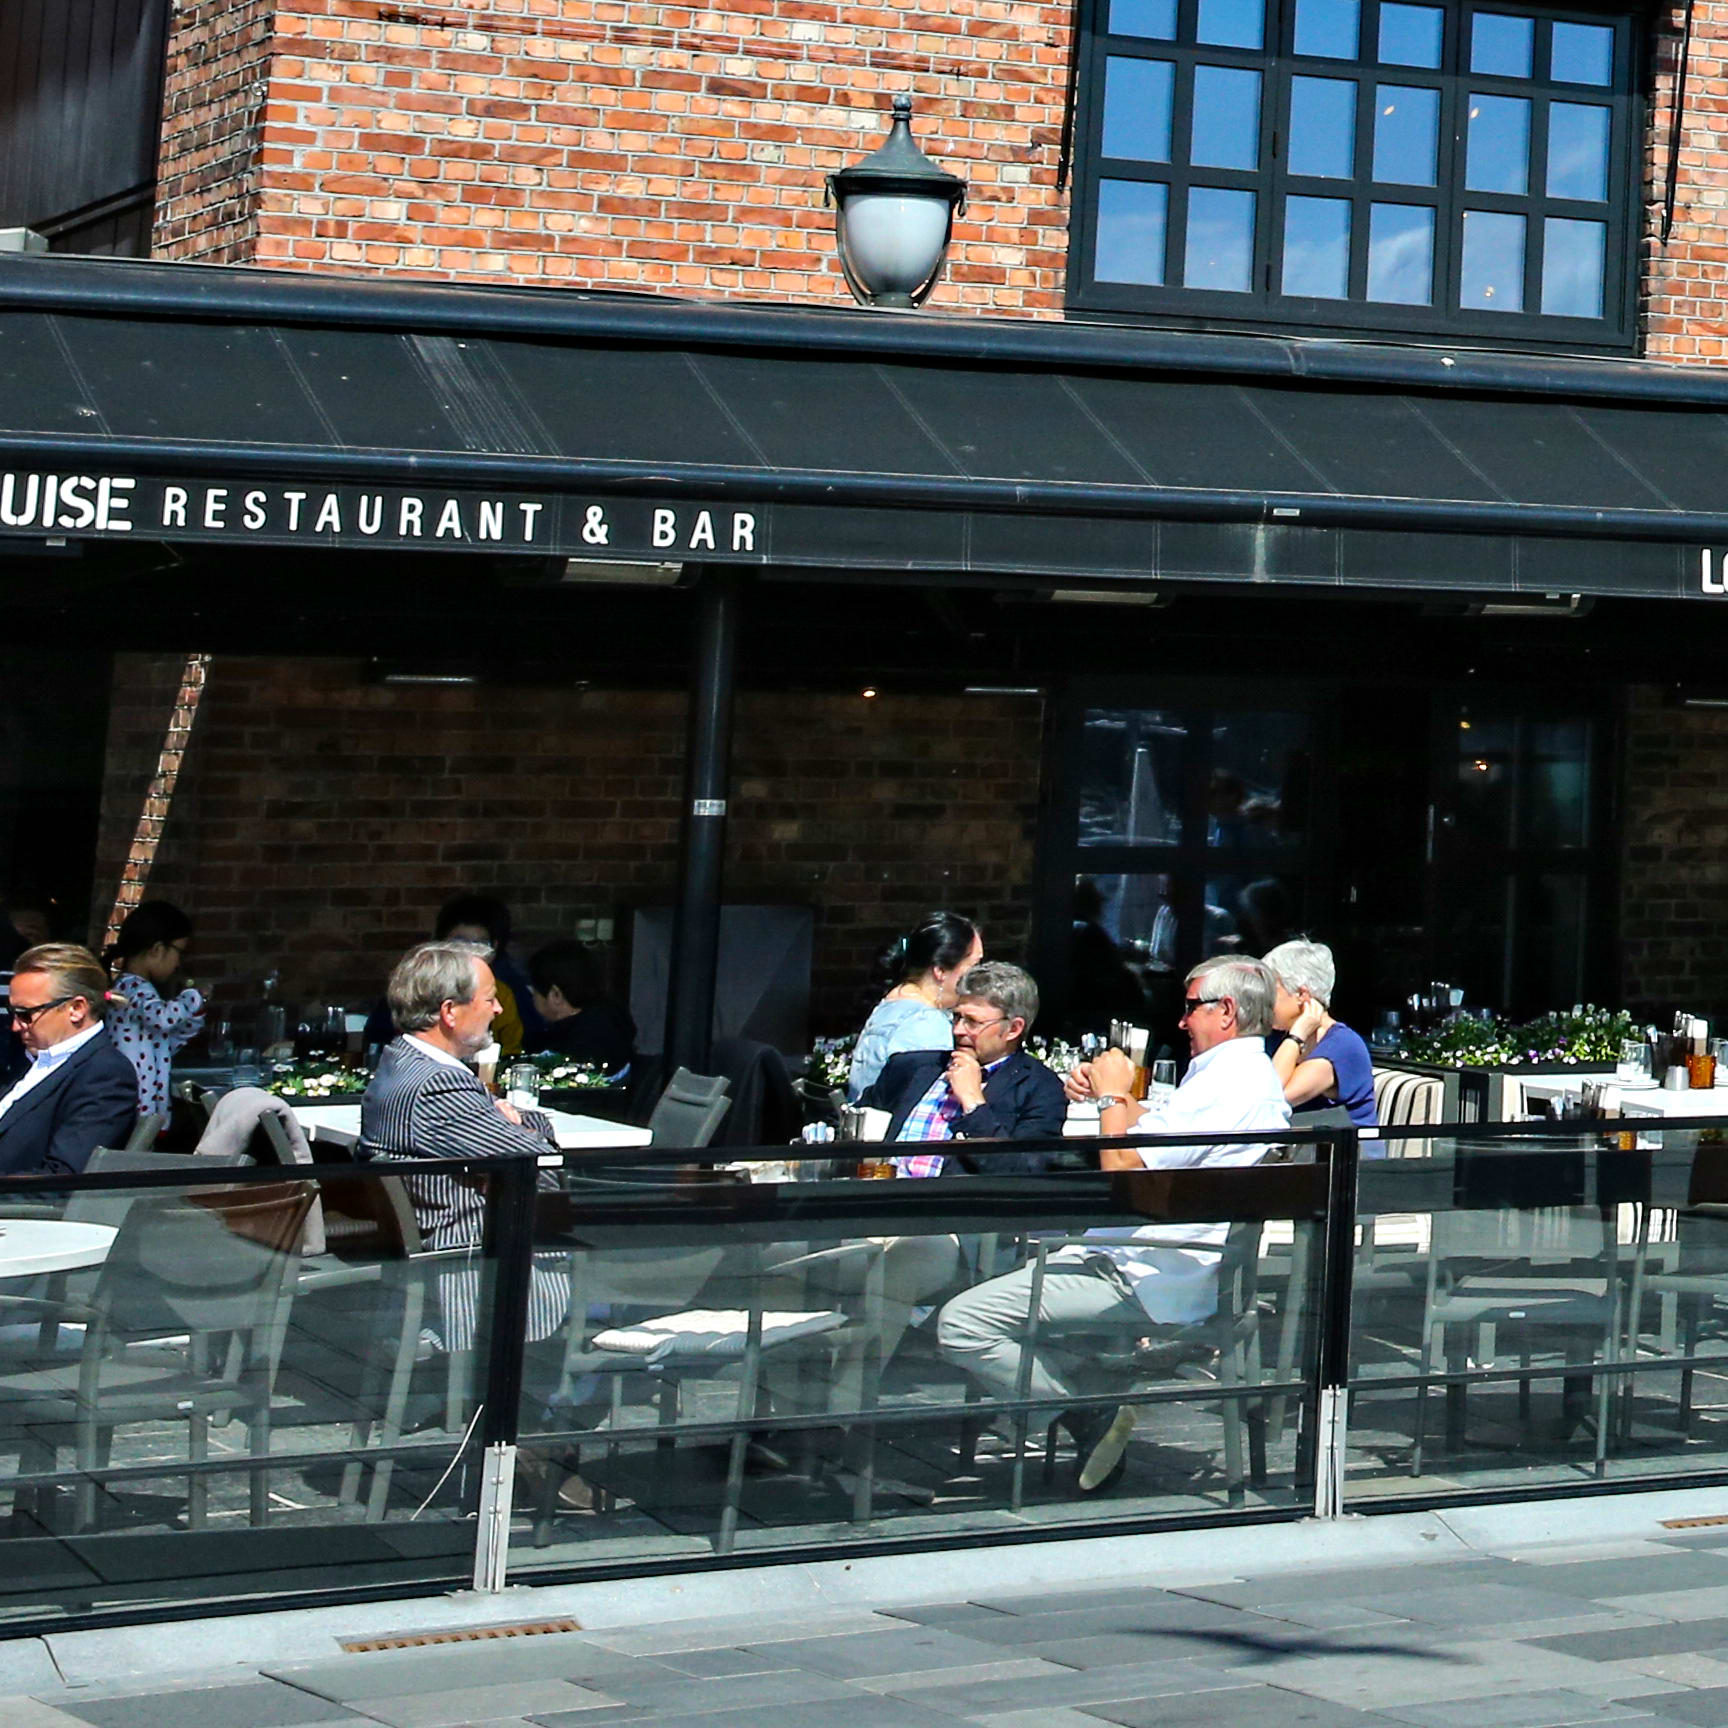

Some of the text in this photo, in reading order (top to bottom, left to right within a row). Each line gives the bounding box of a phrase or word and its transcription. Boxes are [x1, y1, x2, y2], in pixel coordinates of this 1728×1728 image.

[162, 486, 543, 542] RESTAURANT
[581, 504, 609, 545] &
[652, 508, 756, 552] BAR
